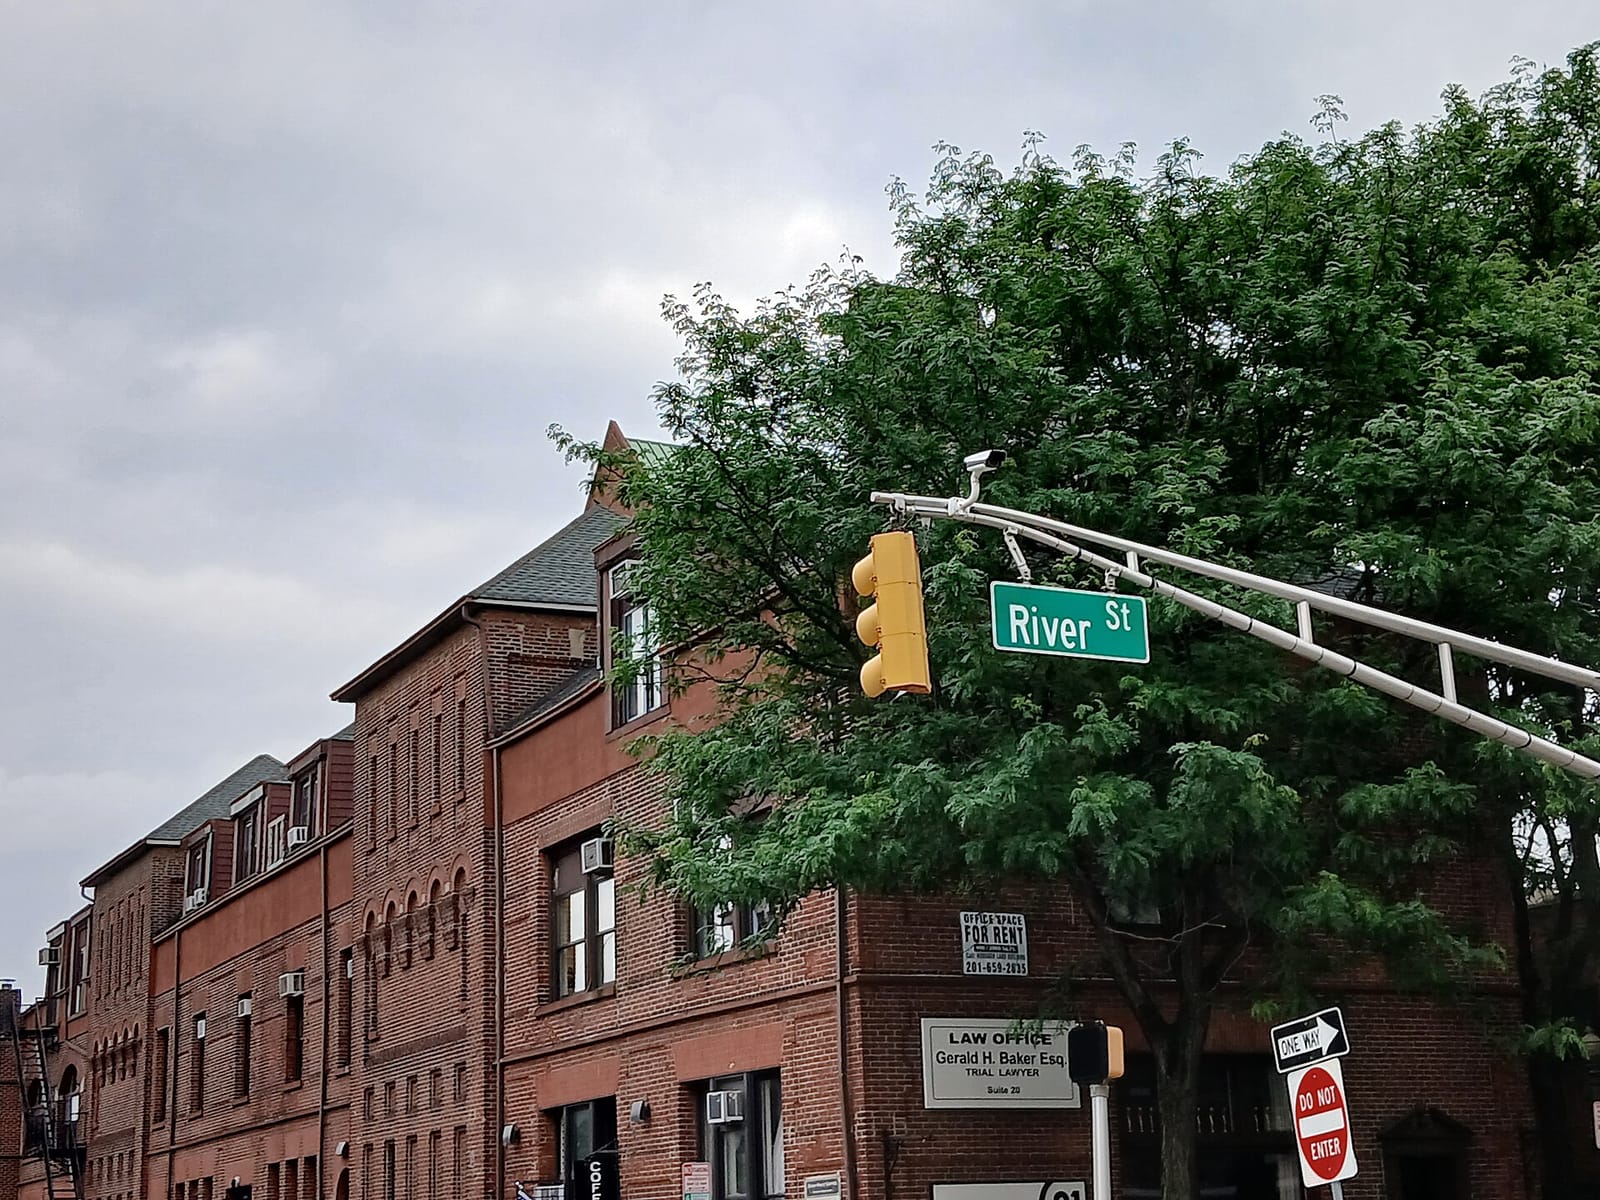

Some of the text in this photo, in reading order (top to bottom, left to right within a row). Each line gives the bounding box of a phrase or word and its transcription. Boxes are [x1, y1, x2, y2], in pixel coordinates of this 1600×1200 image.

[1009, 600, 1131, 650] River St
[965, 925, 1023, 945] FOR RENT
[950, 1033, 1052, 1045] LAW OFFICE
[1281, 1029, 1320, 1056] ONE WAY
[936, 1051, 1067, 1068] Gerald H. Baker Esq.
[966, 1068, 1039, 1077] TRIAL LAWYER
[987, 1086, 1008, 1094] Suite
[1300, 1085, 1335, 1112] DO NOT
[1311, 1137, 1341, 1160] ENTER
